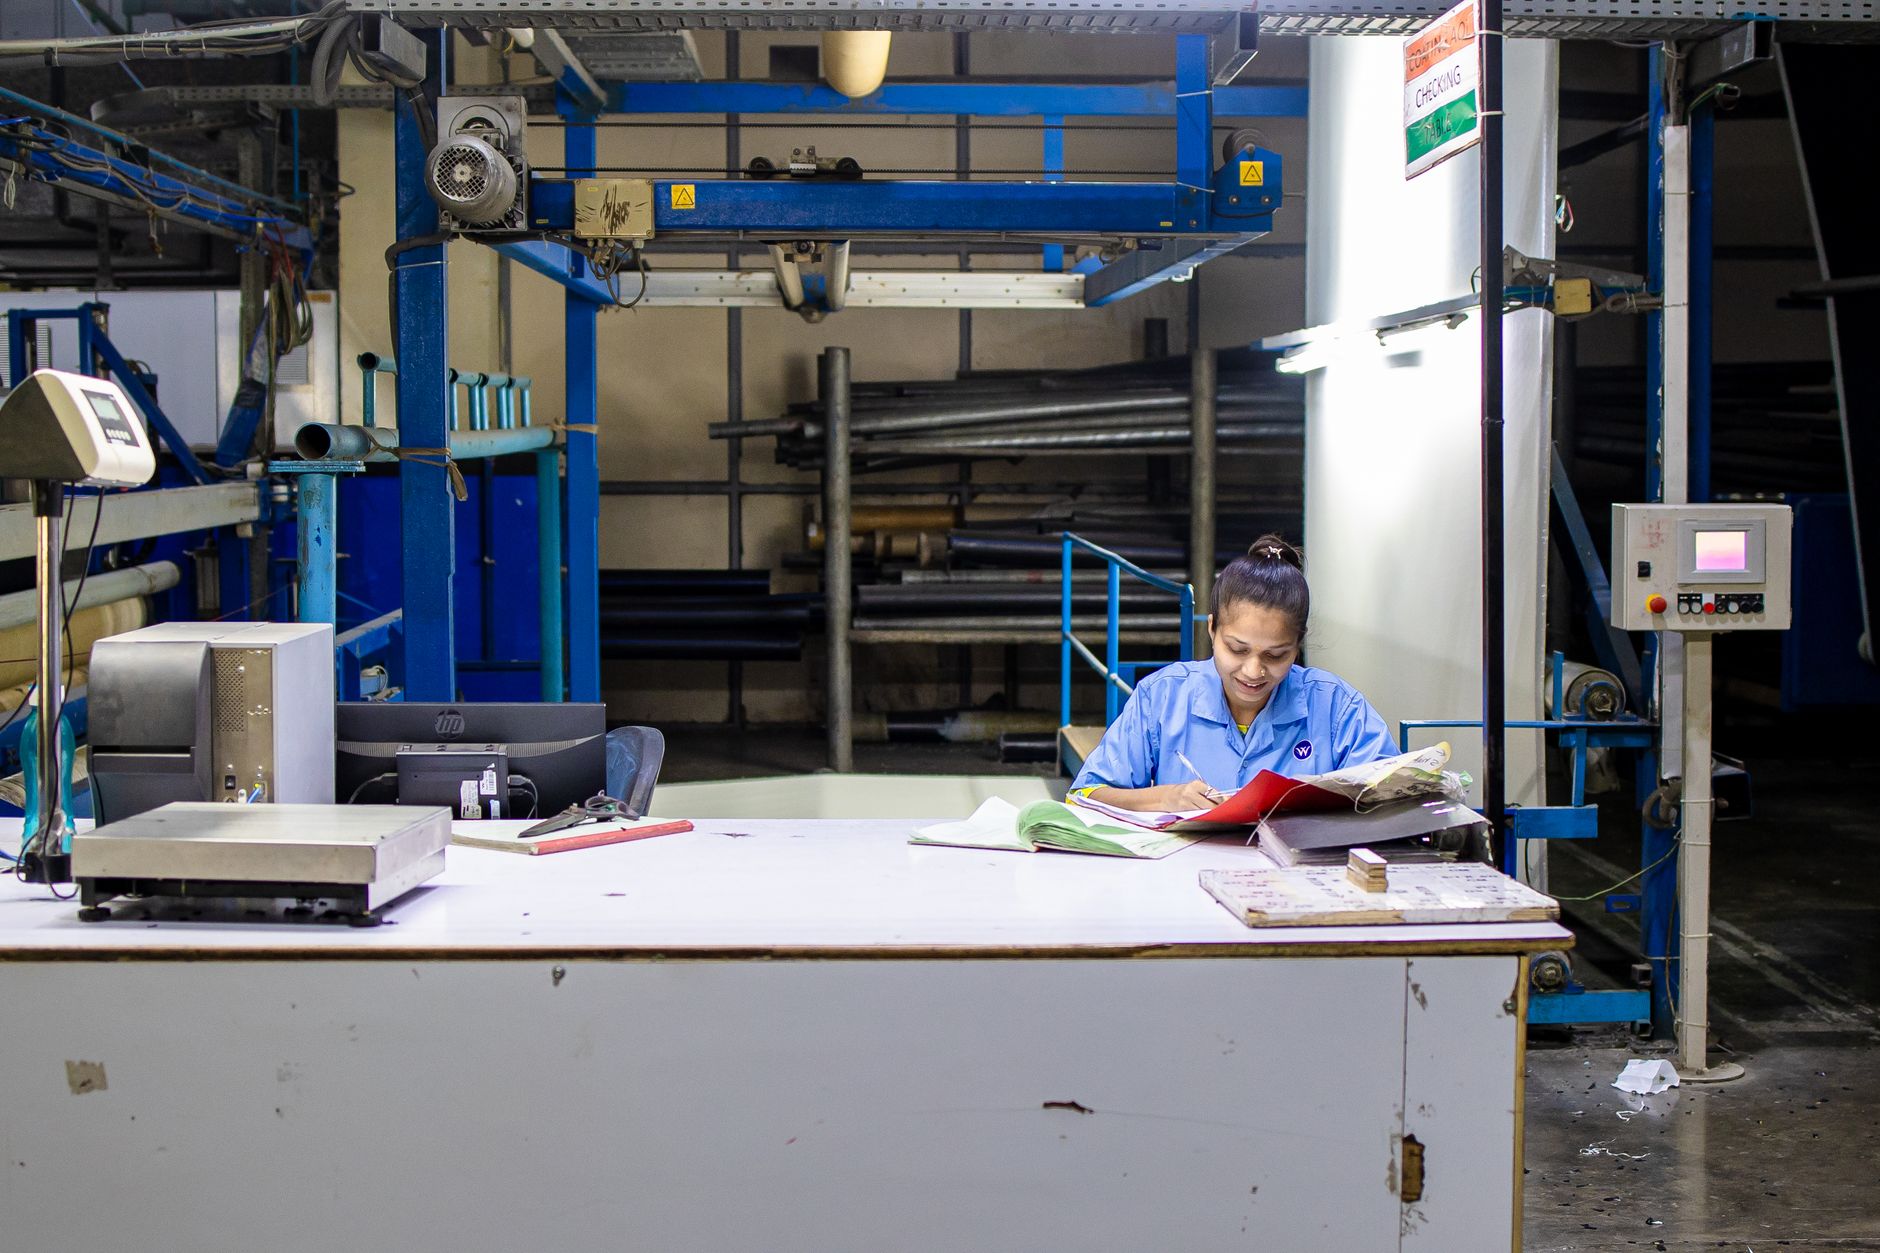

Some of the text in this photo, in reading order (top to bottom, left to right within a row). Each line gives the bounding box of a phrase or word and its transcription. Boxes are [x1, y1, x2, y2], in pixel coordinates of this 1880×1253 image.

[1416, 65, 1461, 108] CHECKING
[1424, 112, 1452, 144] TABLE
[437, 709, 464, 738] hp
[1296, 745, 1311, 757] W
